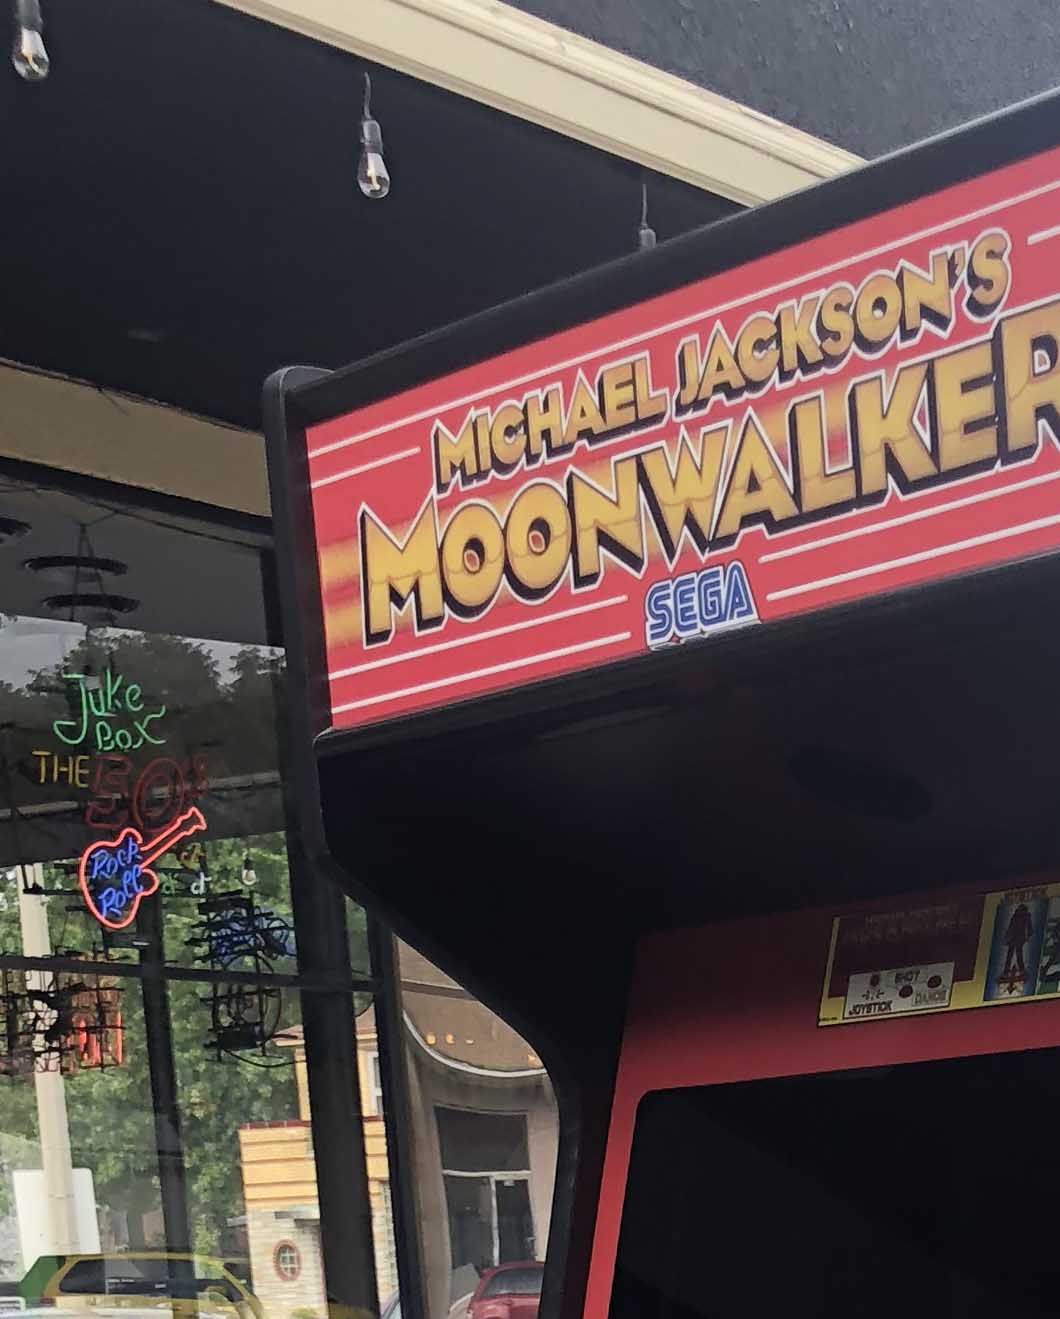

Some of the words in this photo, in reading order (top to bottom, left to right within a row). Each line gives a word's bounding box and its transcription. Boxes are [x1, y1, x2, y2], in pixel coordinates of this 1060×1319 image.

[433, 353, 672, 495] MICHAEL
[675, 228, 1011, 418] JACKSON'S
[643, 558, 761, 649] SEGA
[53, 668, 145, 744] Juke
[32, 751, 90, 788] THE
[91, 837, 143, 880] Rock
[101, 865, 144, 917] Roll
[848, 1000, 893, 1015] JOYSTICK
